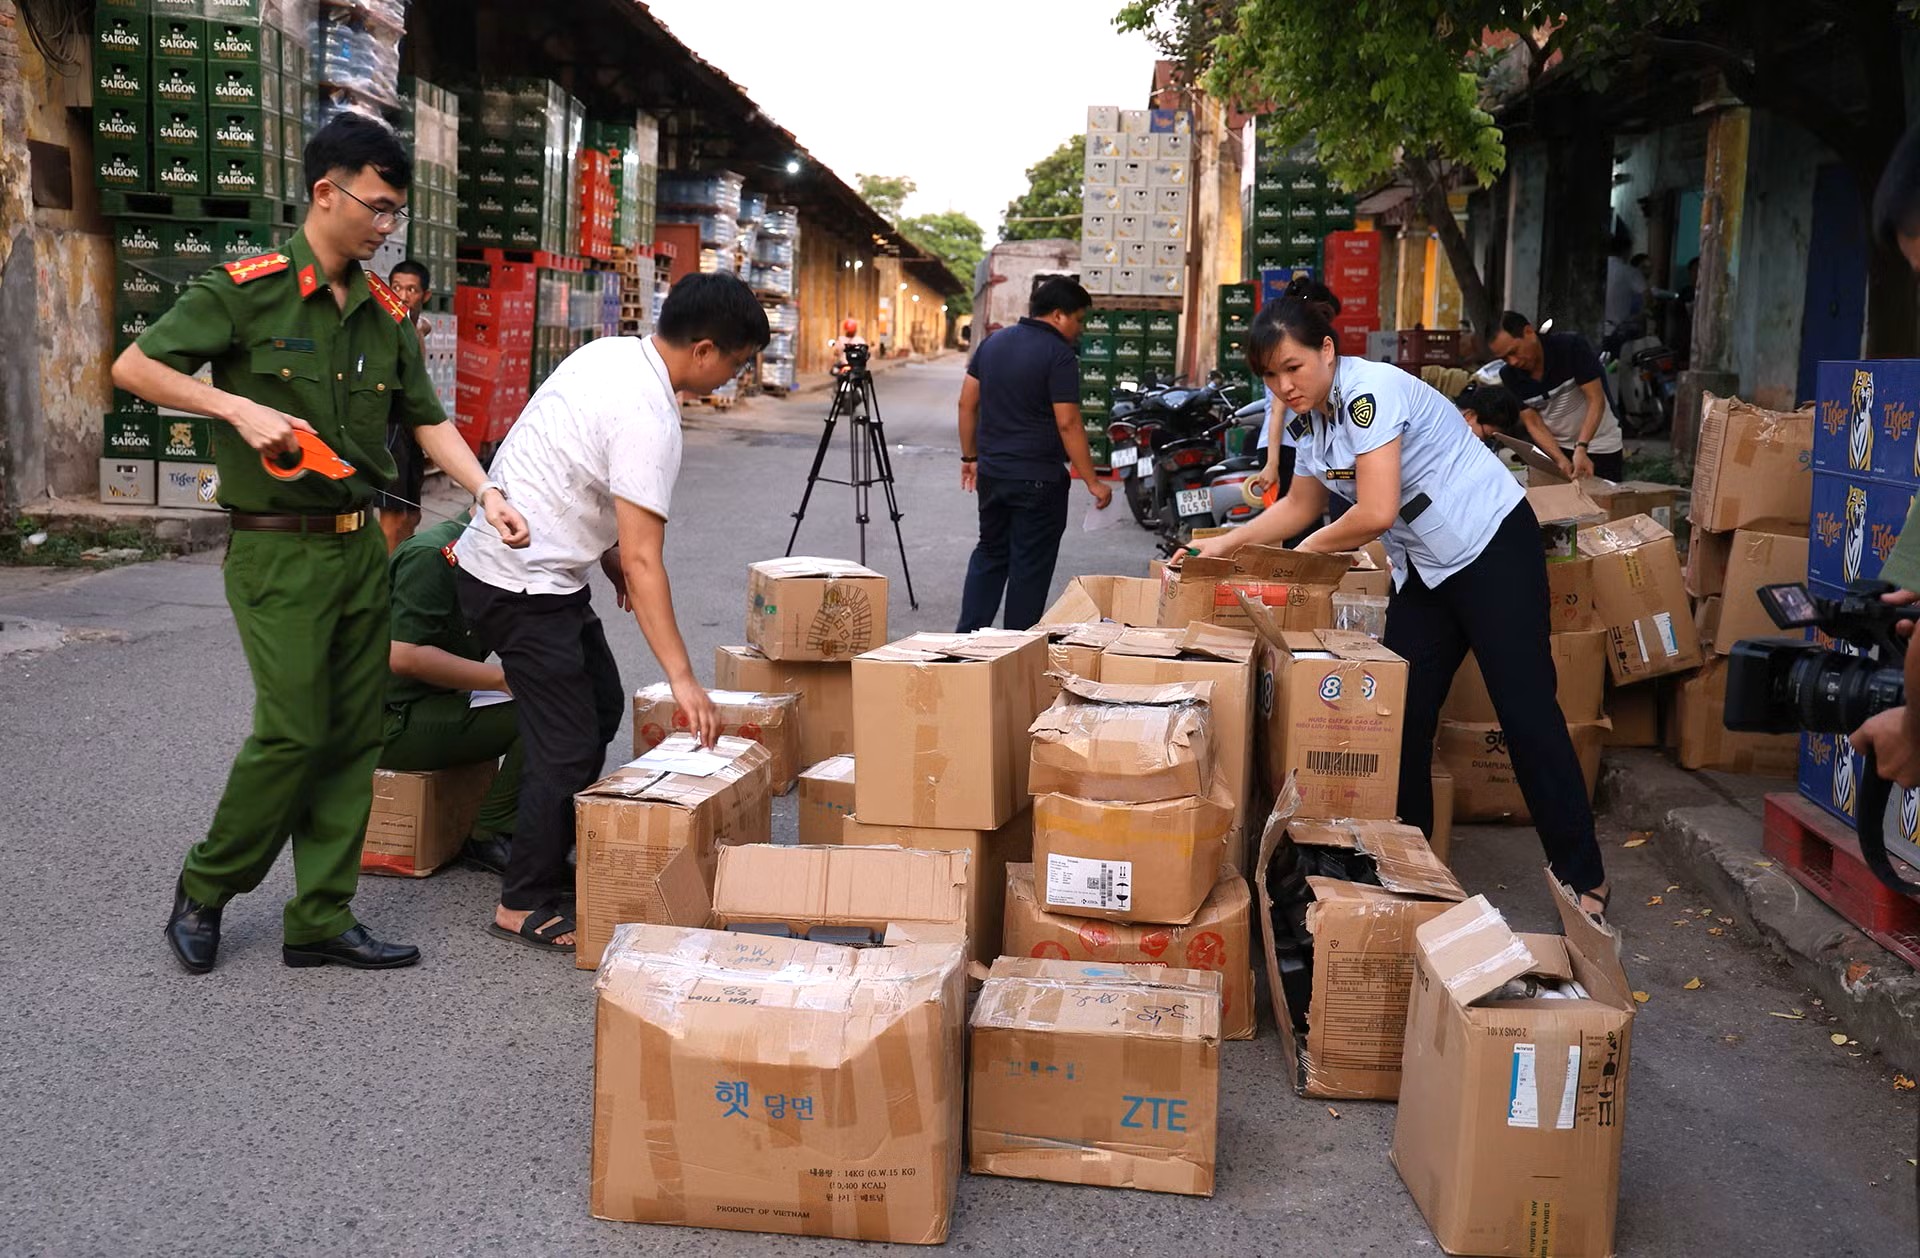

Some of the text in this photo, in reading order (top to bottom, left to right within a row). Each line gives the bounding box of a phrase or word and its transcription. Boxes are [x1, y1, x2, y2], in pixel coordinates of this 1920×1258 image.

[101, 34, 139, 45] SAIGON
[160, 39, 198, 49] SAIGON
[214, 42, 252, 51] SAIGON
[101, 78, 138, 90] SAIGON
[158, 83, 196, 93] SAIGON
[215, 86, 254, 97] SAIGON
[99, 122, 137, 134] SAIGON
[160, 128, 198, 138] SAIGON
[216, 131, 255, 141] SAIGON
[101, 166, 139, 177] SAIGON
[161, 172, 198, 182] SAIGON
[217, 175, 256, 184] SAIGON
[122, 239, 158, 249] SAIGON
[174, 243, 211, 253] SAIGON
[225, 245, 261, 254] SAIGON
[123, 282, 159, 293] SAIGON
[122, 324, 148, 333] SAIG
[1822, 400, 1848, 436] Tiger
[1883, 401, 1915, 441] Tiger
[111, 437, 150, 446] SAIGON
[165, 447, 196, 456] SAIGON
[169, 472, 196, 486] Tiger
[1816, 512, 1843, 548] Tiger
[1499, 1027, 1504, 1037] X
[1504, 1027, 1522, 1037] CANS
[1522, 1028, 1527, 1037] 2
[714, 1081, 814, 1121] 햇 당면
[1120, 1095, 1188, 1132] ZTE
[844, 1169, 864, 1177] 14KG
[902, 1168, 916, 1176] KG)
[862, 1182, 887, 1190] KCAL)
[716, 1205, 755, 1214] PRODUCT
[773, 1210, 810, 1218] VIETNAM
